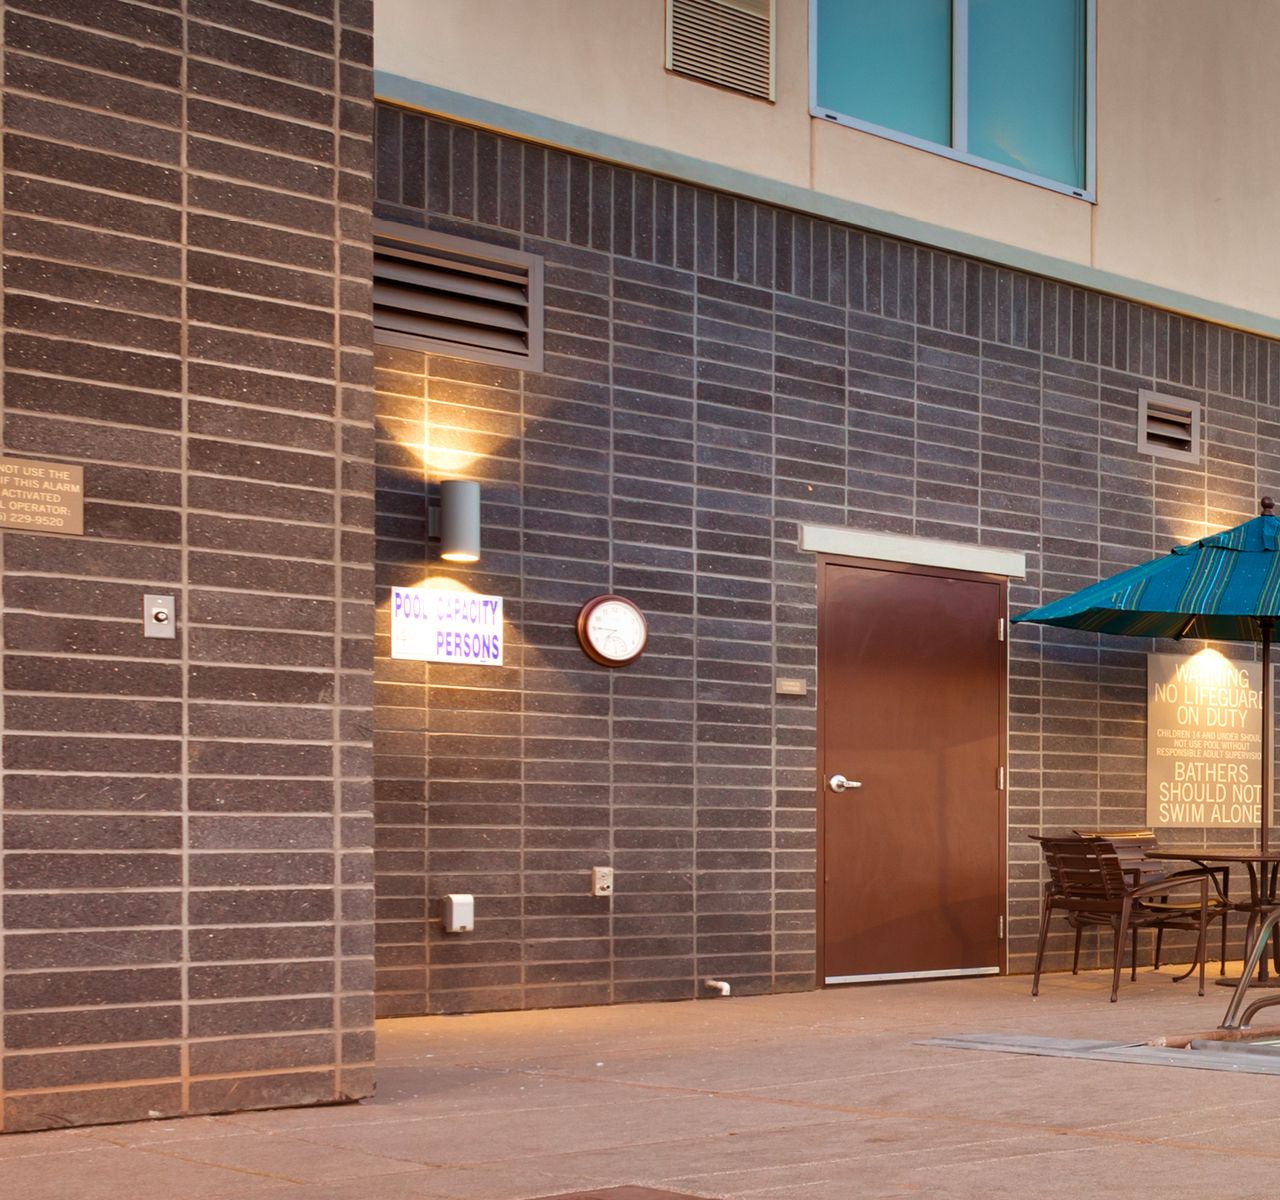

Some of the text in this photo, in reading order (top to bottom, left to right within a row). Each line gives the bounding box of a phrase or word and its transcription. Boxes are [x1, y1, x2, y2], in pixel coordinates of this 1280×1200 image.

[23, 467, 45, 478] USE
[48, 469, 70, 480] THE
[13, 477, 40, 488] THIS
[42, 481, 81, 493] ALARM
[2, 488, 62, 503] ACTIVATED
[9, 501, 71, 516] OPERATOR:
[9, 513, 64, 527] 229-9520
[395, 592, 499, 625] POOL CAPACITY
[437, 631, 499, 660] PERSONS
[1175, 663, 1249, 689] WARNING
[1154, 682, 1178, 704] NO
[1177, 705, 1248, 728] ON DUTY
[1156, 728, 1190, 738] CHILDREN
[1202, 731, 1216, 740] AND
[1217, 732, 1239, 741] UNDER
[1156, 747, 1202, 758] RESPONSIBLE
[1203, 749, 1223, 759] ADULT
[1173, 739, 1250, 751] NOT USE POOL WITHOUT
[1174, 761, 1249, 783] BATHERS
[1159, 782, 1262, 803] SHOULD NOT
[1159, 803, 1262, 823] SWIM ALONE
